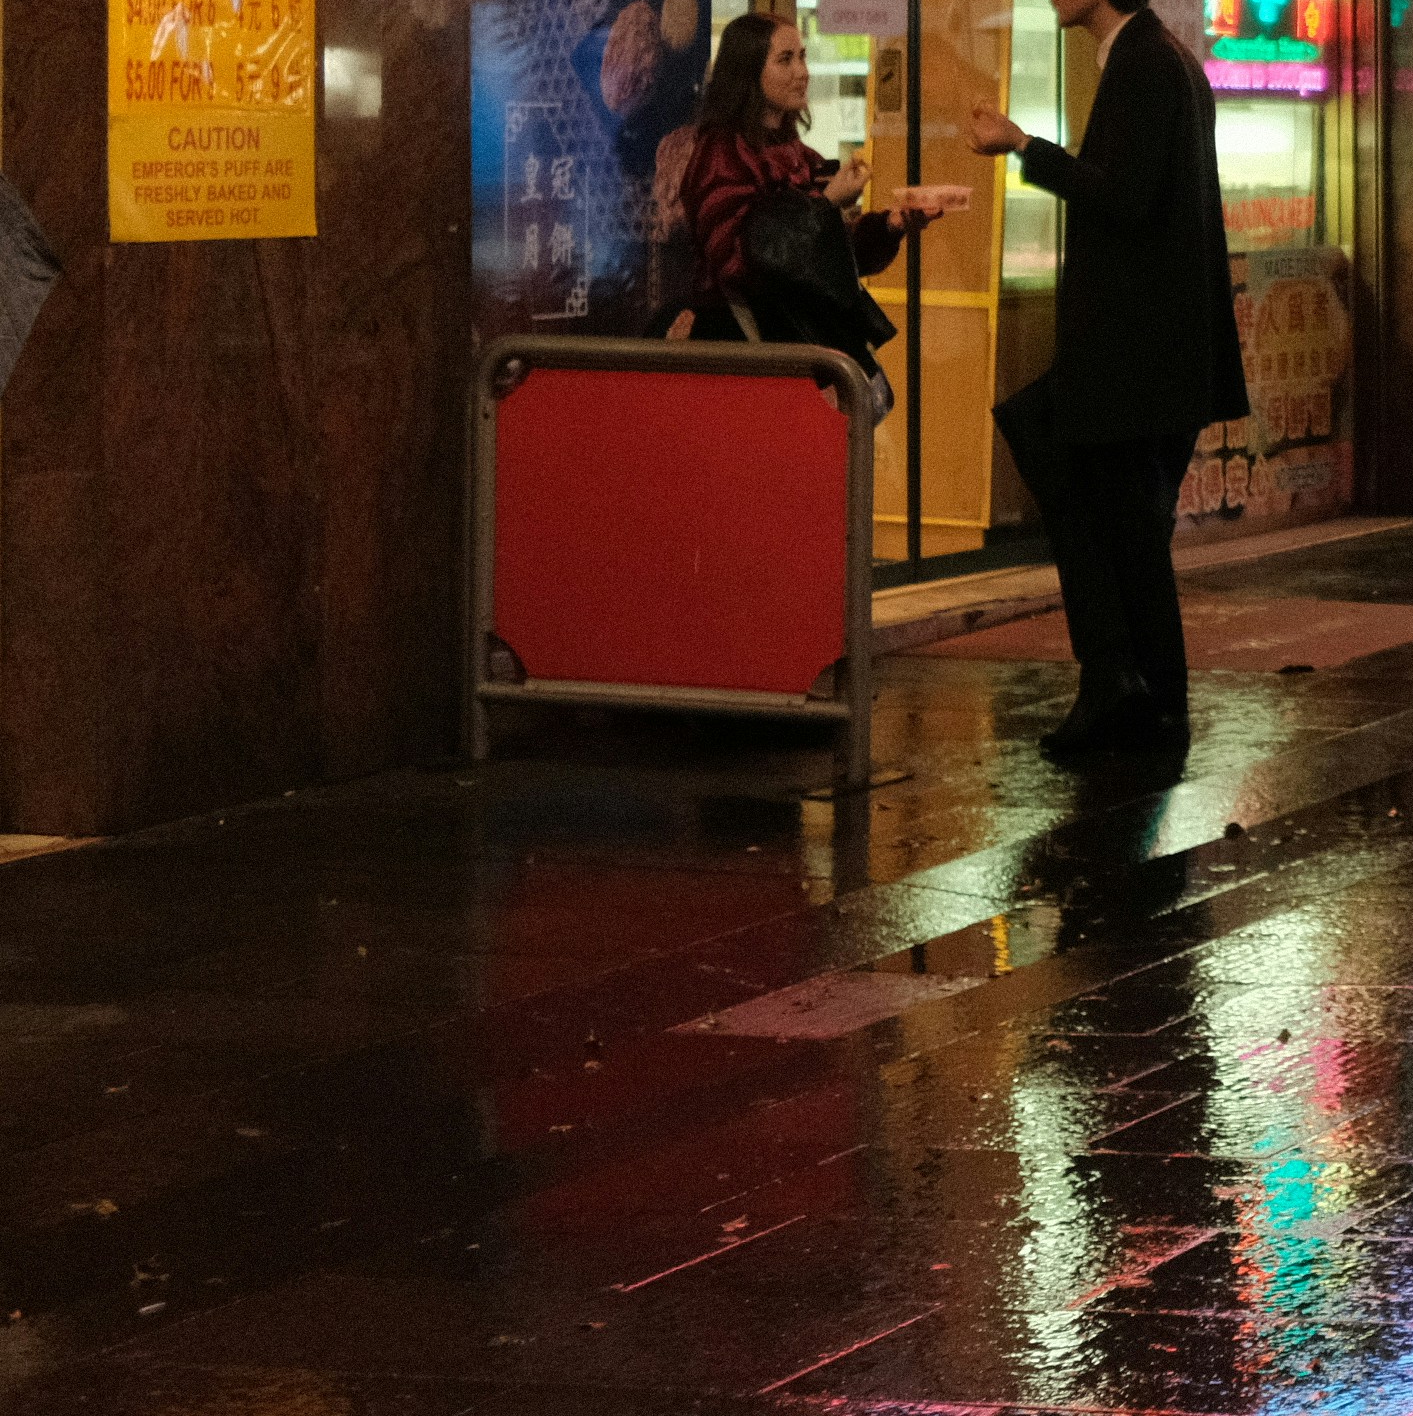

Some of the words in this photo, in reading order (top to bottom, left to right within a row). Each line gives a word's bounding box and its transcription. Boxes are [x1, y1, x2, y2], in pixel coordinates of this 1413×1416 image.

[167, 126, 260, 152] CAUTION
[132, 160, 219, 180] EMPEROR'S
[224, 160, 259, 179] PUFF
[264, 159, 293, 178] ARE
[134, 185, 201, 204] FRESHLY
[207, 184, 257, 202] BAKED
[261, 184, 291, 200] AND
[166, 209, 224, 228] SERVED
